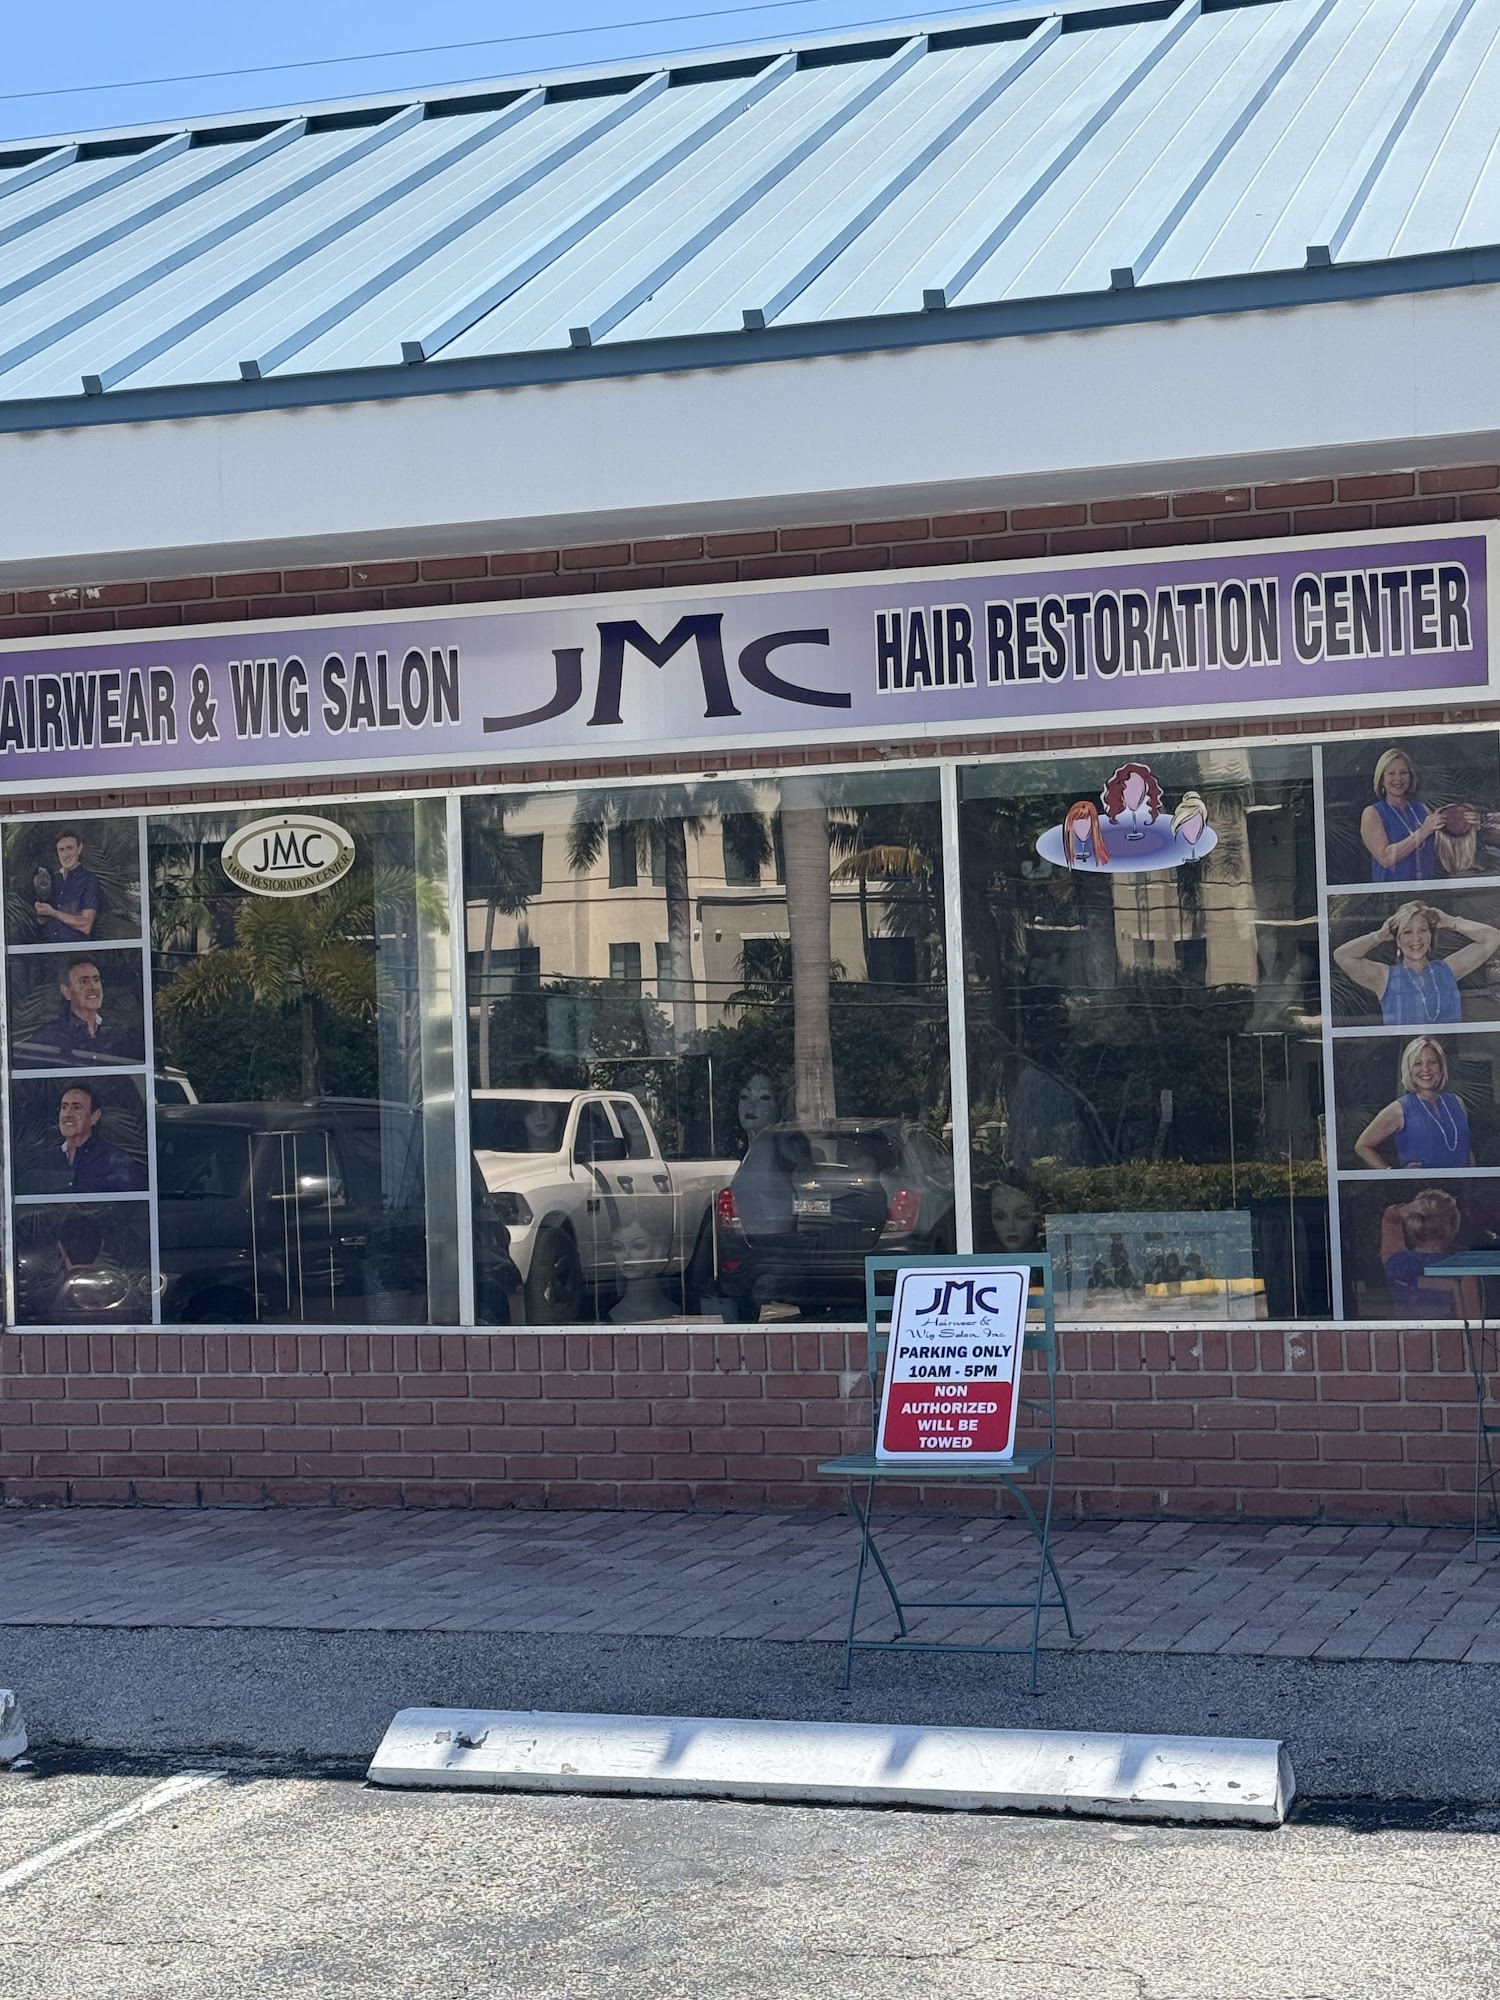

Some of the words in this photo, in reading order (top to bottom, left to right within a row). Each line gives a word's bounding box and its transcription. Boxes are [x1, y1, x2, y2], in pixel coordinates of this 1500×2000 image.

[875, 603, 976, 695] HAIR
[987, 576, 1281, 688] RESTORATION
[1292, 561, 1472, 665] CENTER
[483, 613, 852, 733] JMC
[0, 667, 177, 753] AIRWEAR
[189, 664, 219, 743] &
[229, 655, 310, 739] WIG
[321, 645, 461, 735] SALON
[253, 831, 324, 872] JMC
[228, 862, 250, 885] HAIR
[251, 876, 314, 890] RESTORATION
[317, 854, 349, 883] CENTER
[915, 1280, 999, 1315] JMC
[979, 1315, 992, 1326] &
[905, 1329, 935, 1340] Wig
[939, 1329, 980, 1339] Salon
[899, 1346, 967, 1358] PARKING
[972, 1345, 1012, 1358] ONLY
[909, 1365, 951, 1377] 10AM
[964, 1365, 998, 1377] 5PM
[934, 1385, 968, 1397] NON
[901, 1402, 998, 1414] AUTHORIZED
[918, 1420, 954, 1431] WILL
[958, 1419, 978, 1431] BE
[919, 1437, 973, 1449] TOWED
